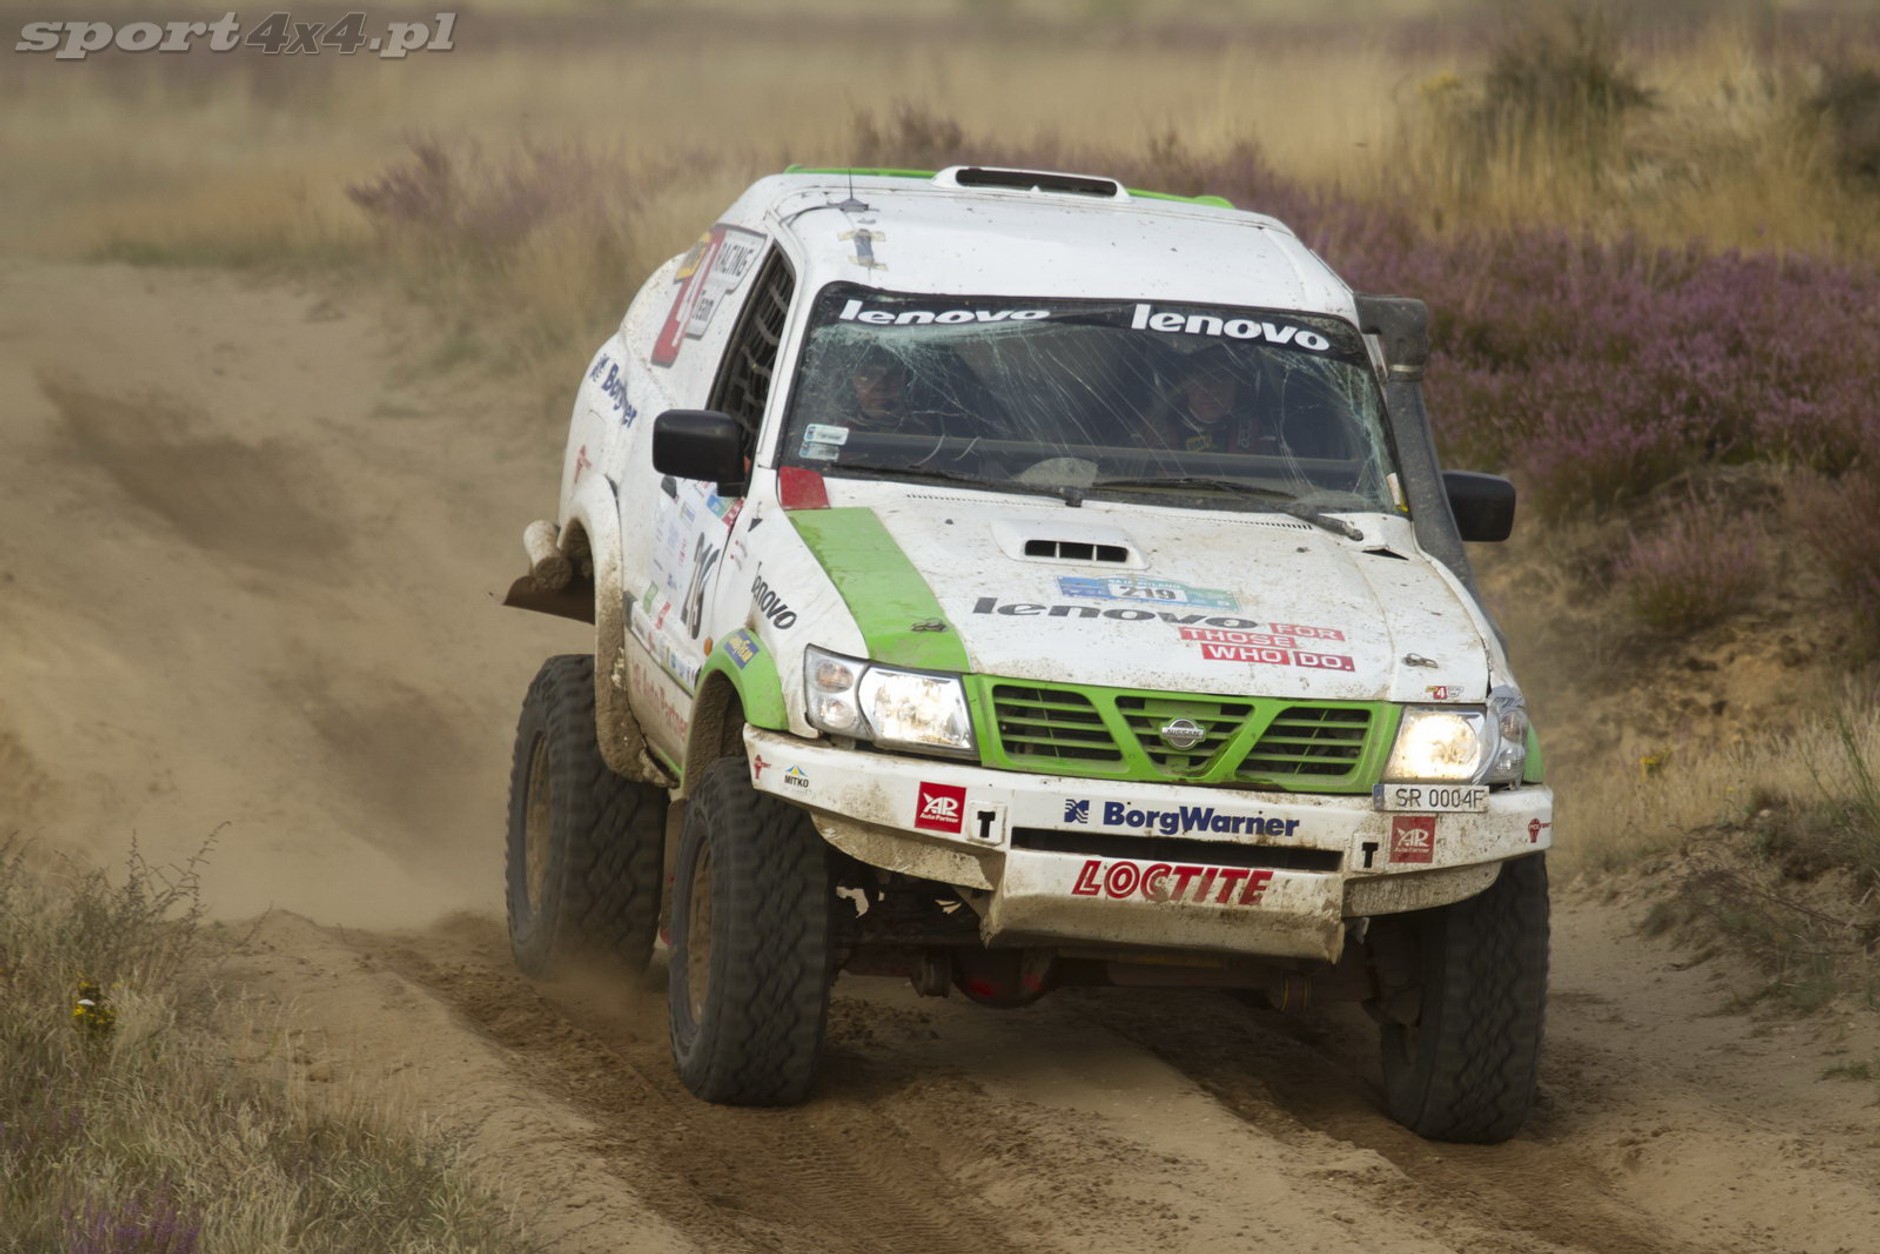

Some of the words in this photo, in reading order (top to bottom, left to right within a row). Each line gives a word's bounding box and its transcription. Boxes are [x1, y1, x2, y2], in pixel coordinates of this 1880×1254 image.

[839, 299, 1051, 325] lenovo
[1131, 303, 1330, 351] lenovo
[750, 560, 797, 630] lenovo
[1119, 585, 1176, 600] 219
[972, 597, 1259, 629] lenovo
[1185, 628, 1293, 648] THOSE
[1275, 623, 1339, 640] FOR
[1208, 645, 1282, 663] WHO
[1299, 653, 1352, 670] DO.
[784, 774, 810, 788] MITKO
[1396, 788, 1422, 807] SR
[977, 810, 996, 838] T
[1103, 801, 1300, 836] BorgWarner
[1361, 841, 1379, 869] T
[1071, 859, 1274, 906] LOCTITE
